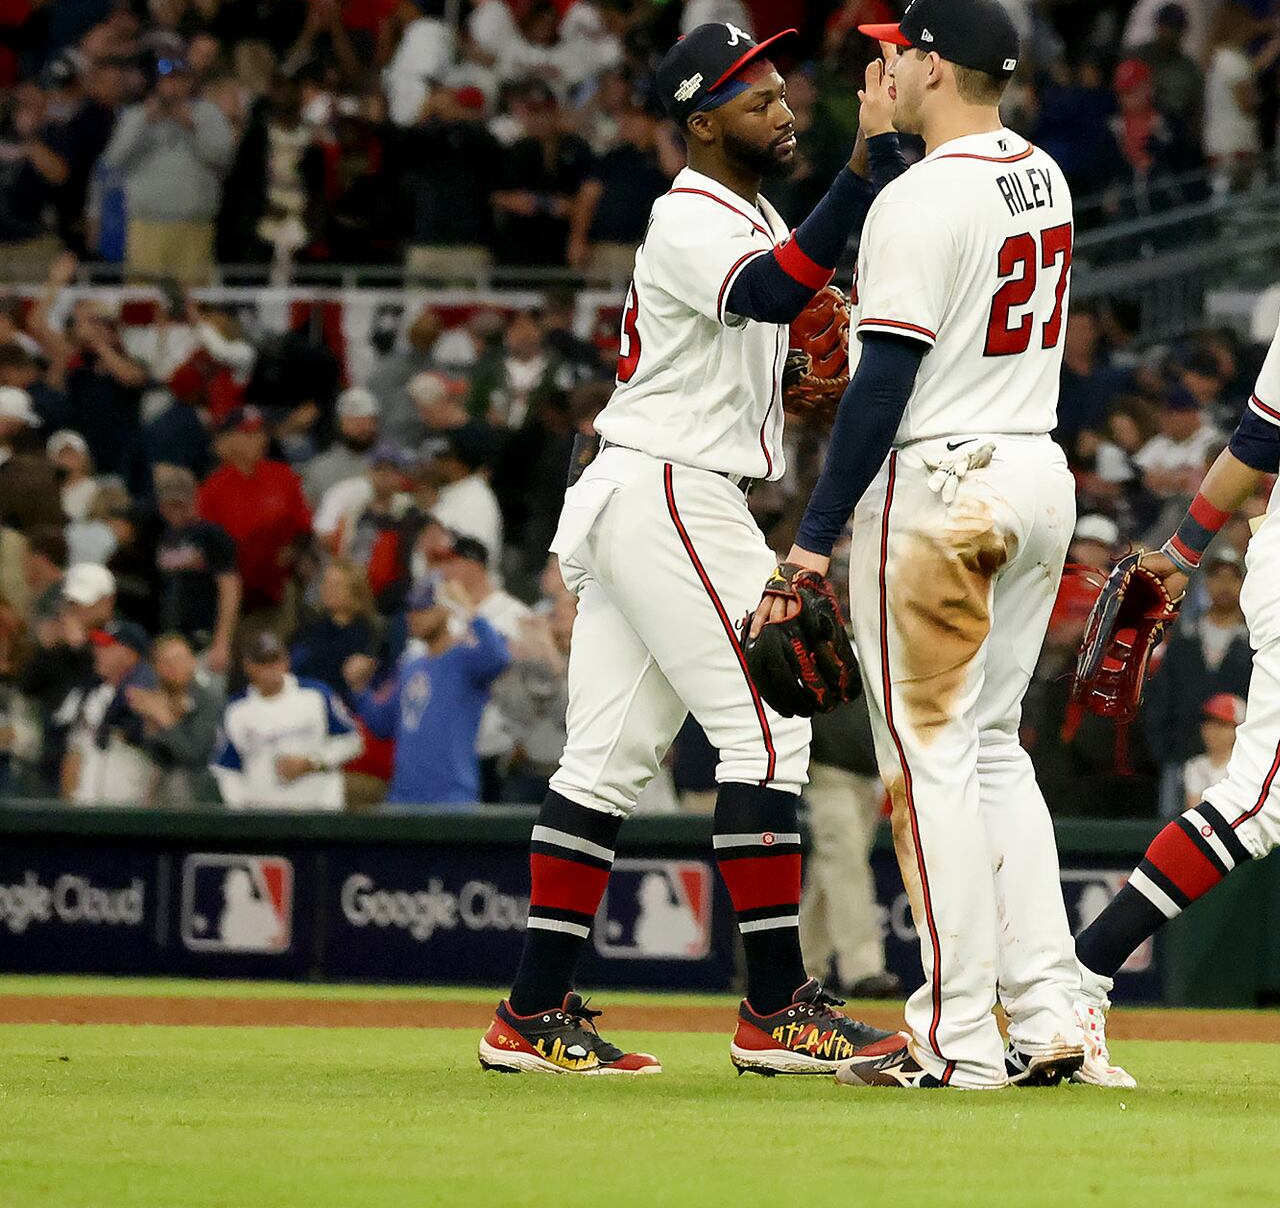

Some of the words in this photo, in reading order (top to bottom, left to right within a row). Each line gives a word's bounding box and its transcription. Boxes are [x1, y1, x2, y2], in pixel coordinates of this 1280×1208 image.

[996, 168, 1054, 216] RILEY
[983, 221, 1073, 357] 27
[54, 874, 145, 925] Cloud
[341, 873, 459, 941] Google
[772, 1021, 854, 1061] ATLANTA
